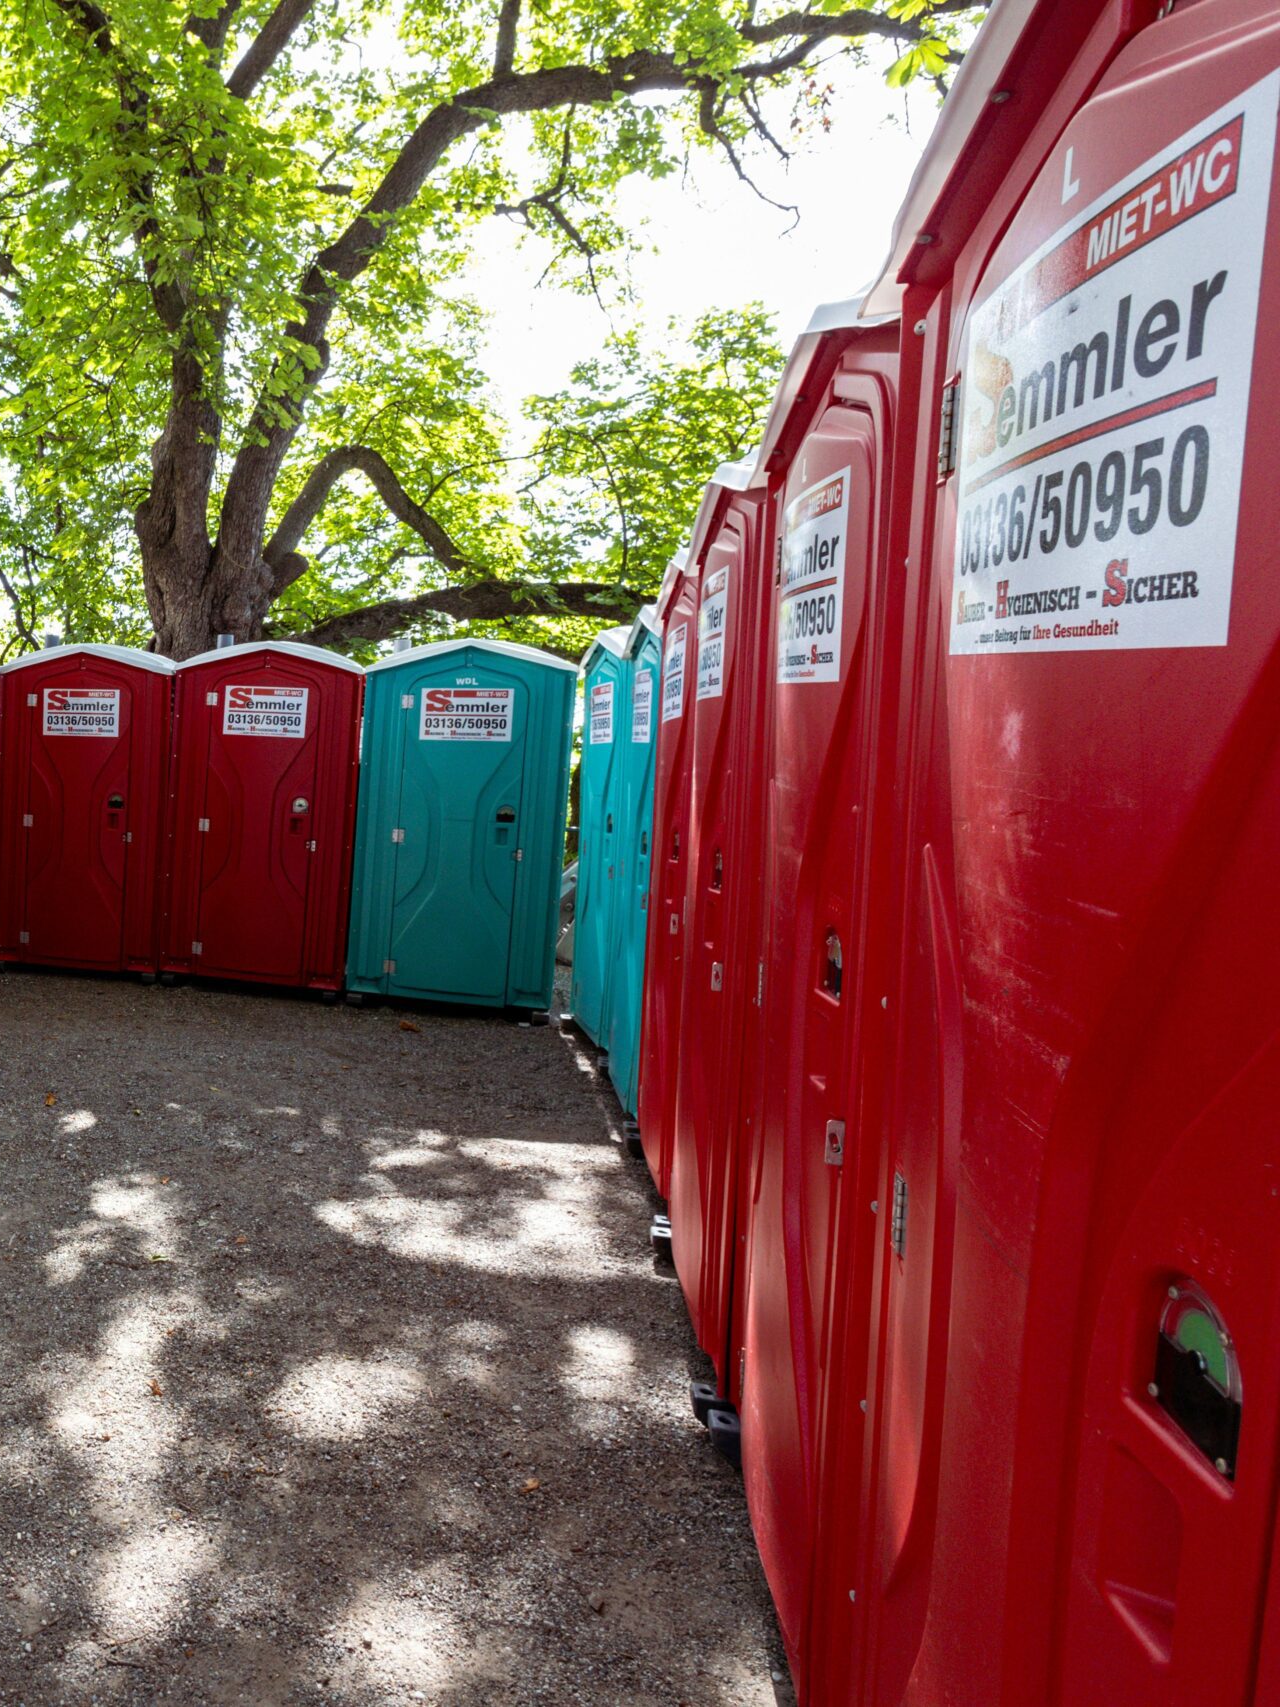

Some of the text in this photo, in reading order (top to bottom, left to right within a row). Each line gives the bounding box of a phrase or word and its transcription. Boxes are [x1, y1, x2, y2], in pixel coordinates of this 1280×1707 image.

[1061, 146, 1080, 206] L
[1086, 138, 1232, 270] MIET-WC
[960, 424, 1209, 577] 03136/50950
[995, 580, 1081, 619] HYGIENISCH
[1102, 559, 1199, 608] SICHER
[994, 627, 1018, 644] Beitrag
[1019, 626, 1031, 642] für
[1032, 625, 1050, 640] Ihre
[1053, 619, 1119, 638] Gesundheit
[47, 690, 115, 711] Semmler
[229, 687, 302, 710] Semmler
[426, 690, 508, 712] Semmler
[47, 716, 114, 726] 03136/50950
[228, 714, 301, 726] 03136/50950
[425, 718, 507, 729] 03136/50950
